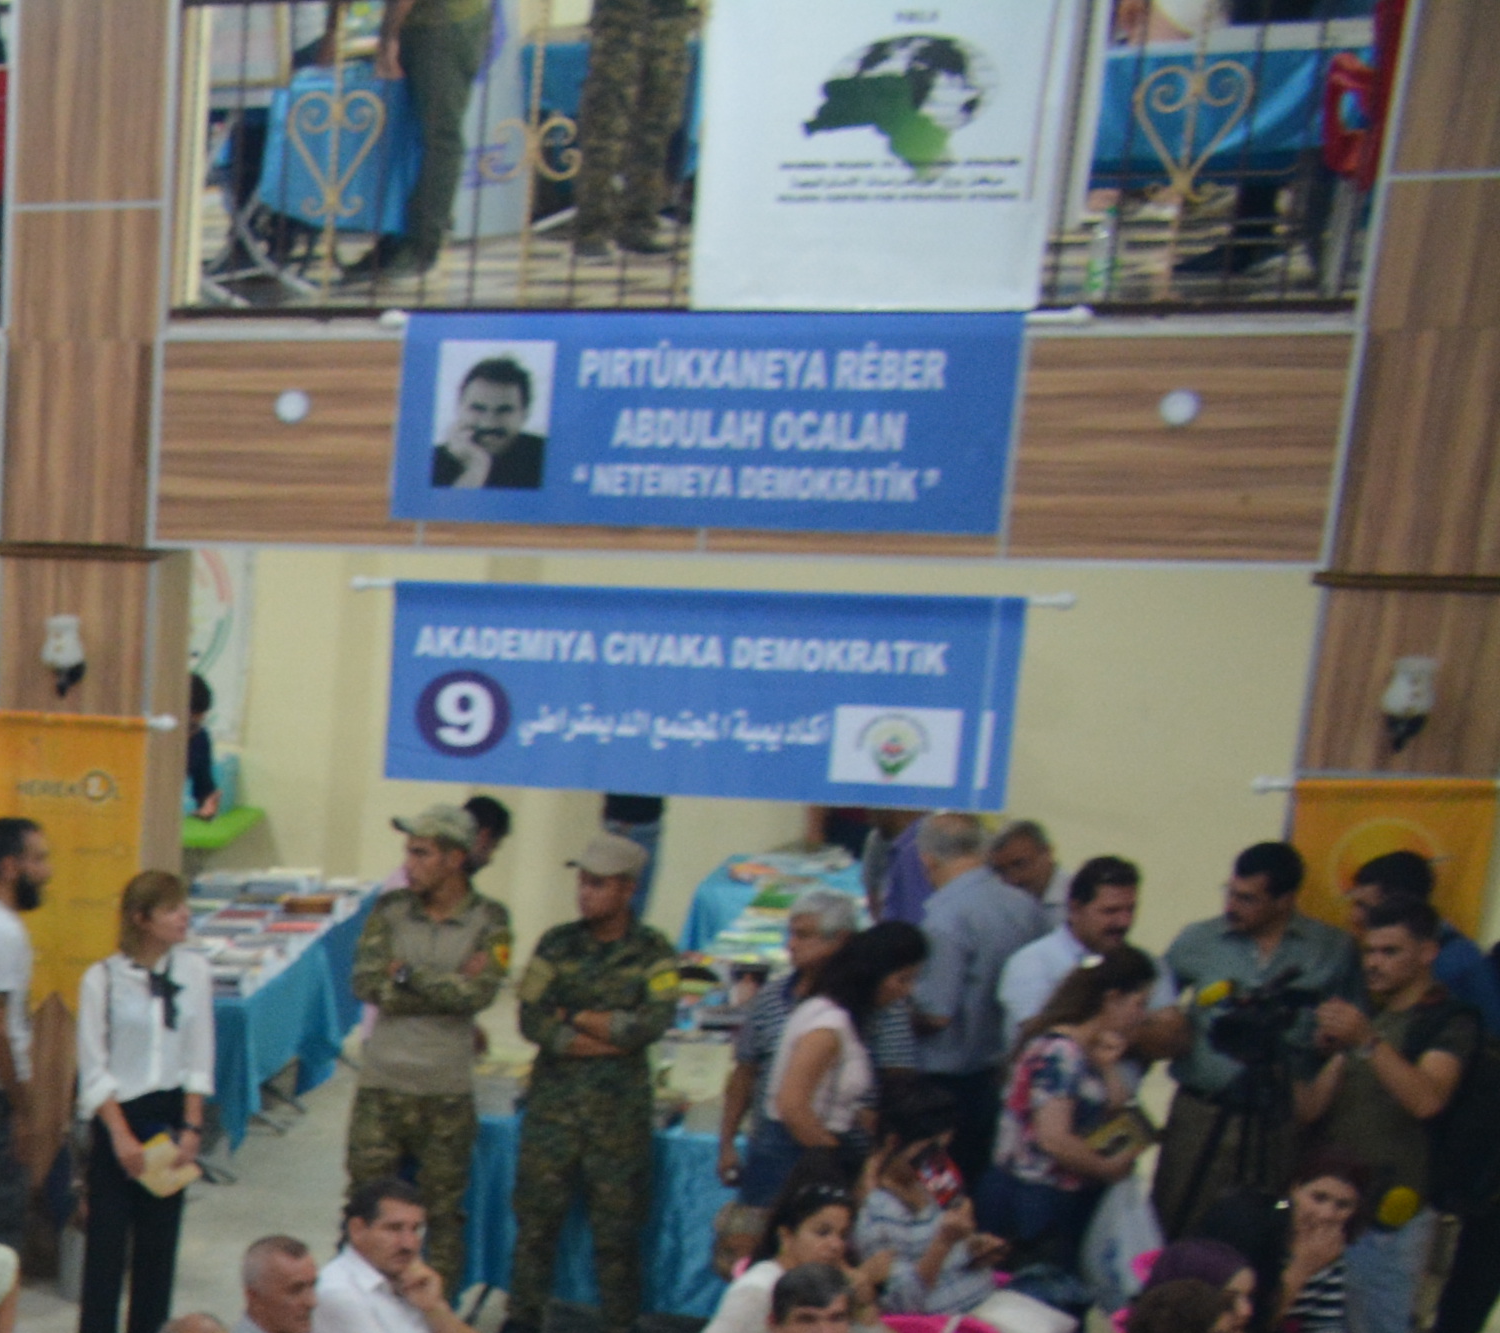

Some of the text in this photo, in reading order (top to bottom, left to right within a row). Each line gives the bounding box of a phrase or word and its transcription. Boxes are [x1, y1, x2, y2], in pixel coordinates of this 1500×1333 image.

[611, 408, 906, 452] ABDULAH OCALAN
[414, 624, 596, 663] AKADEMIYA
[604, 631, 725, 667] CIVAKA
[434, 680, 497, 748] 9
